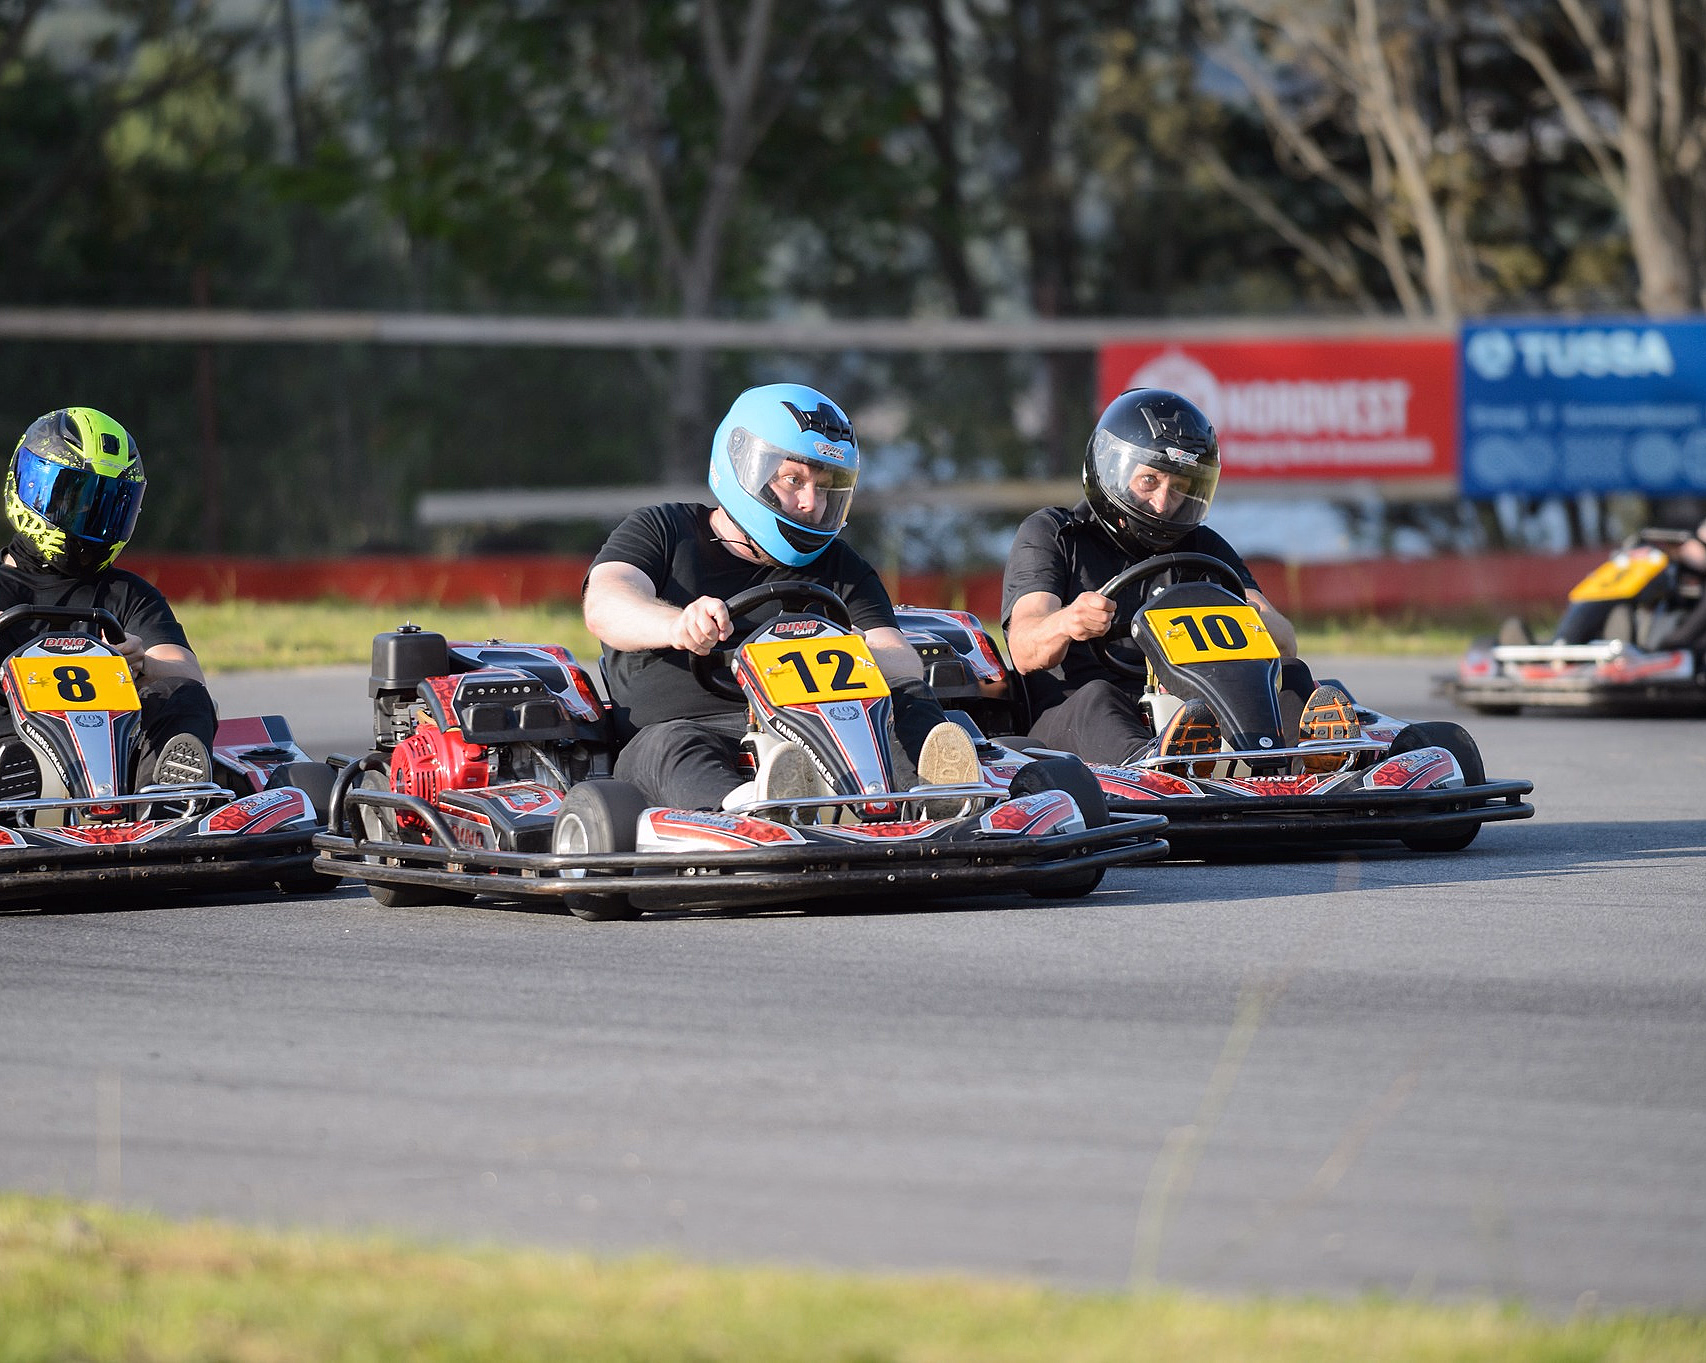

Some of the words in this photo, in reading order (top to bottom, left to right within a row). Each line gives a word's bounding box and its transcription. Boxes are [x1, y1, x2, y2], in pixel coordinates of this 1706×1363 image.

[1518, 331, 1673, 378] TUSSA
[44, 638, 86, 647] DINO
[775, 620, 818, 633] DINO
[1169, 614, 1249, 652] 10
[52, 665, 97, 703] 8
[777, 649, 868, 694] 12
[77, 821, 135, 831] DINO
